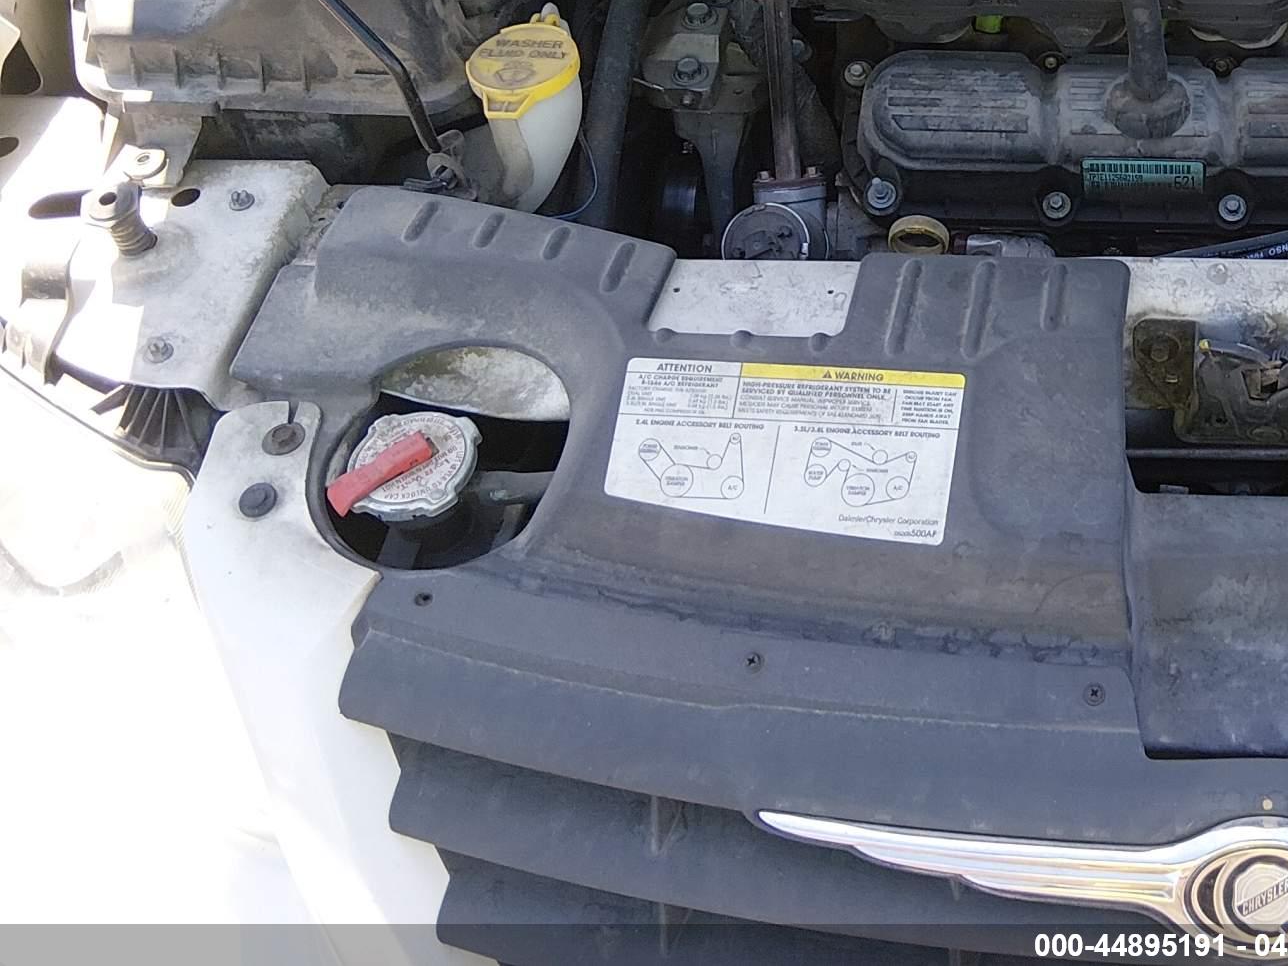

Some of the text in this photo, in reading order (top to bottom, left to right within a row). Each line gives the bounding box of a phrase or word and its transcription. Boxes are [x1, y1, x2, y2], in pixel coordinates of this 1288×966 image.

[495, 38, 564, 49] WASHER
[479, 48, 568, 59] FLUID ONLY
[656, 363, 713, 374] ATTENTION
[835, 372, 884, 382] WARNING
[676, 420, 717, 429] ACCESSORY
[852, 427, 892, 436] ACCESSORY
[910, 431, 941, 439] ROUTING
[838, 514, 939, 526] DaimlerChrysler Corporation
